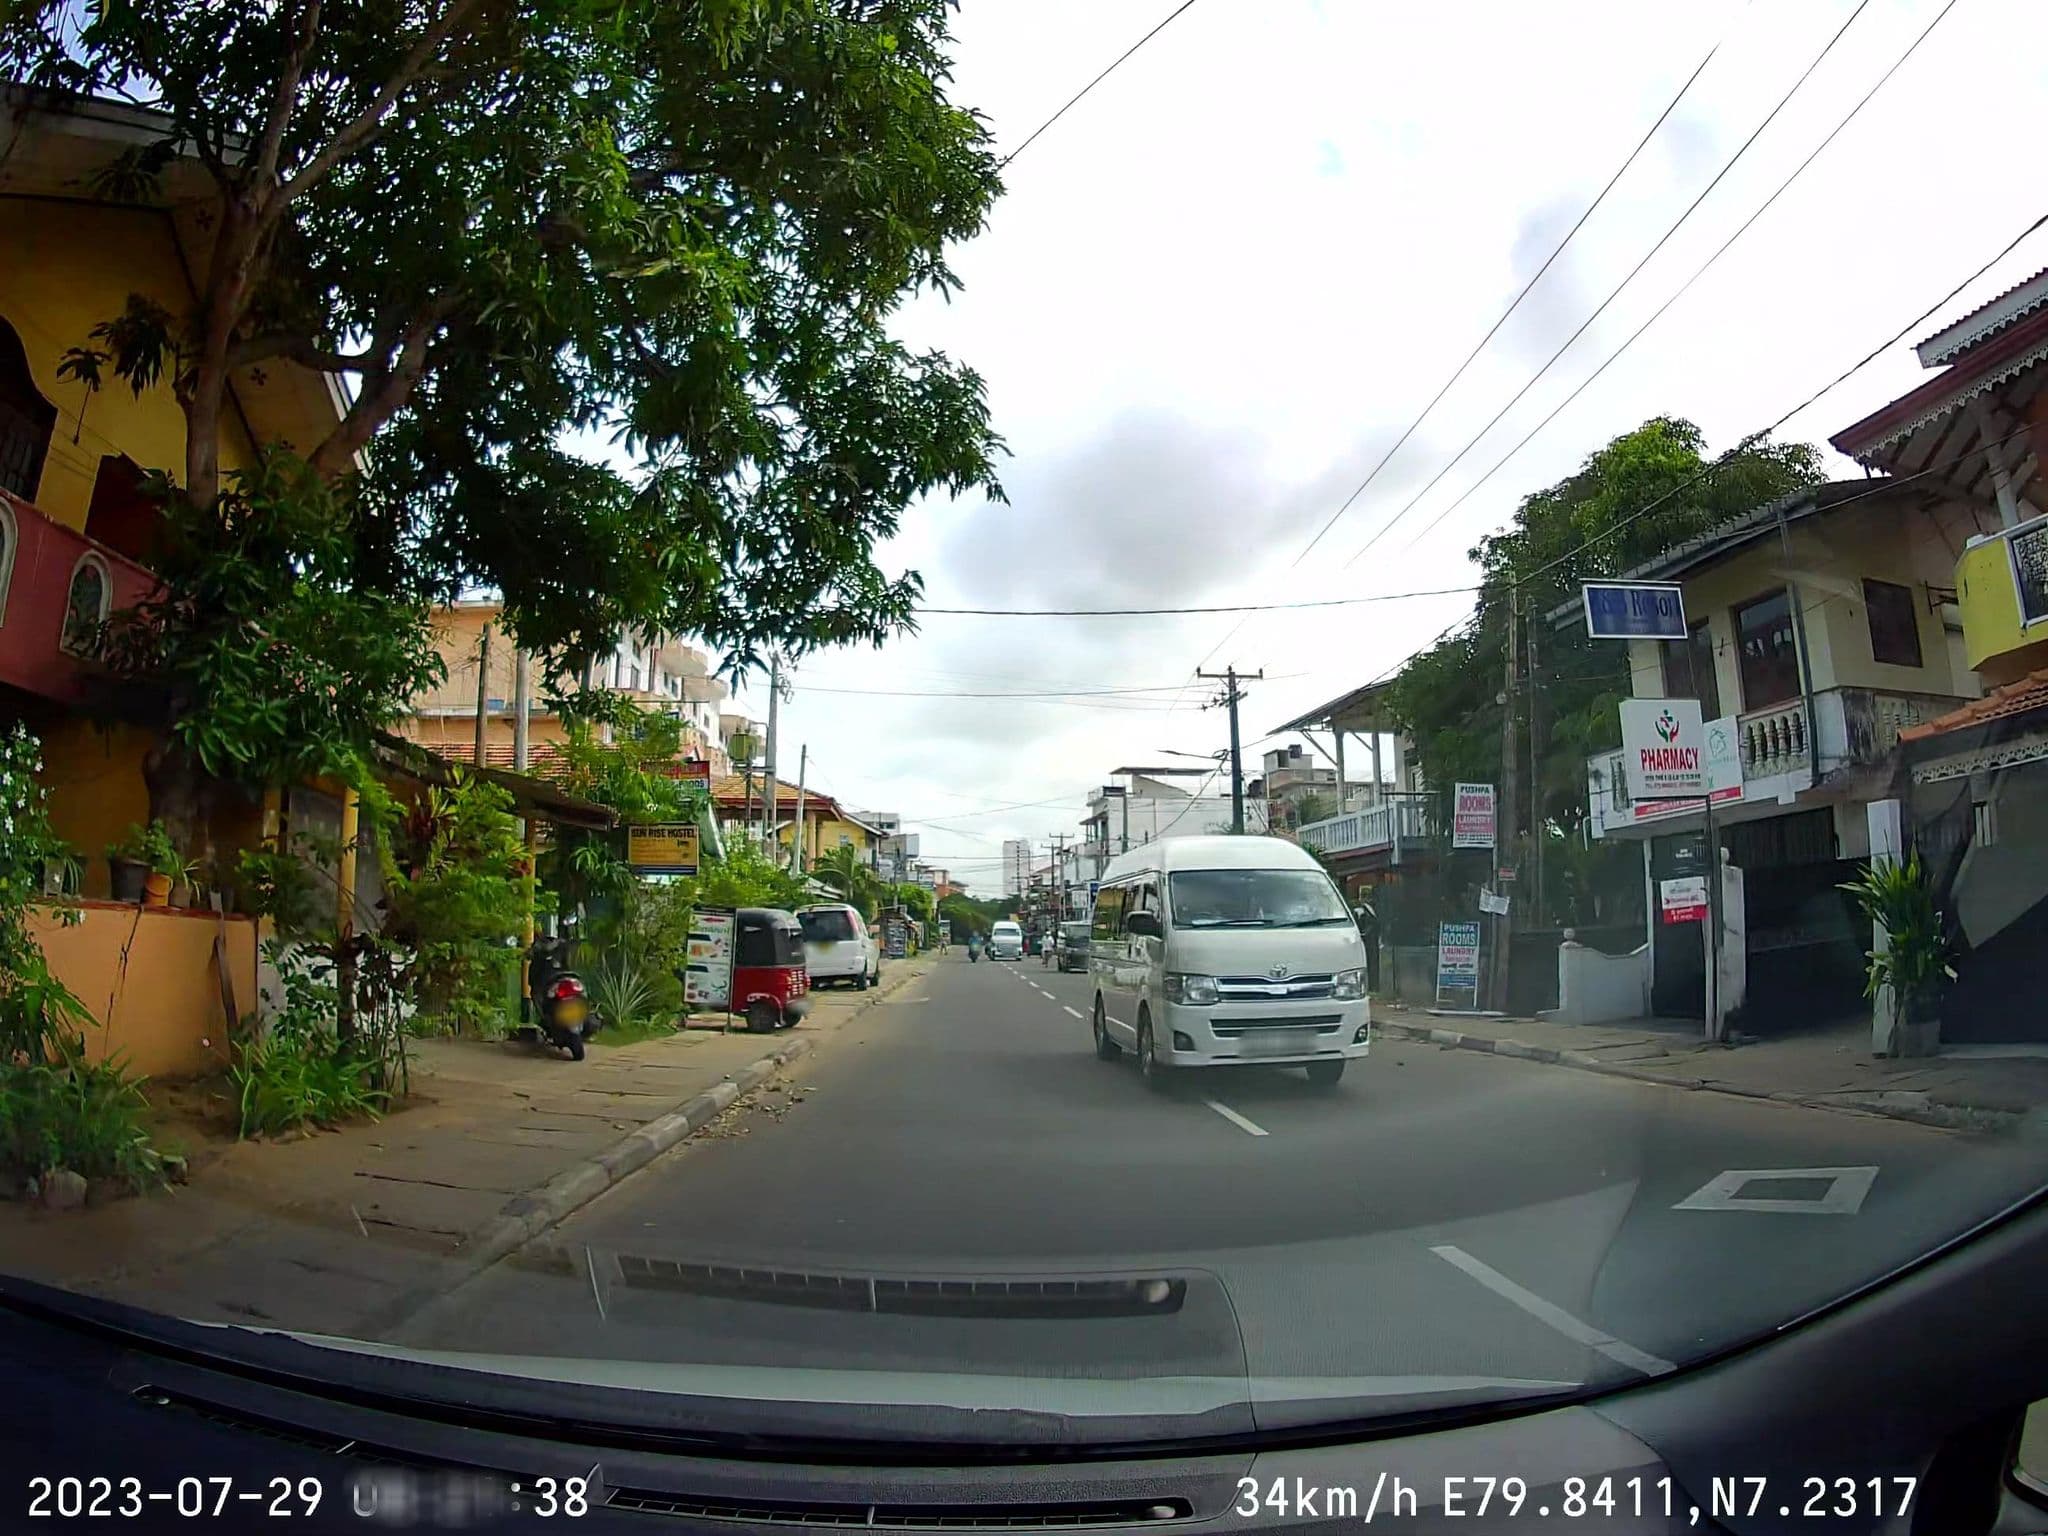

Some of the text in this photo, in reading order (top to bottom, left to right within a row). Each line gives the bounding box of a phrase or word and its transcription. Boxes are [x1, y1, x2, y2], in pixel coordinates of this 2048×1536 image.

[1641, 748, 1699, 771] PHARMACY
[1460, 786, 1490, 794] PUSHPA
[1459, 795, 1491, 812] ROOMS
[649, 828, 667, 837] RISE
[668, 828, 694, 838] HOSTEL
[1444, 924, 1475, 932] PUSHPA
[1442, 932, 1476, 945] ROOMS
